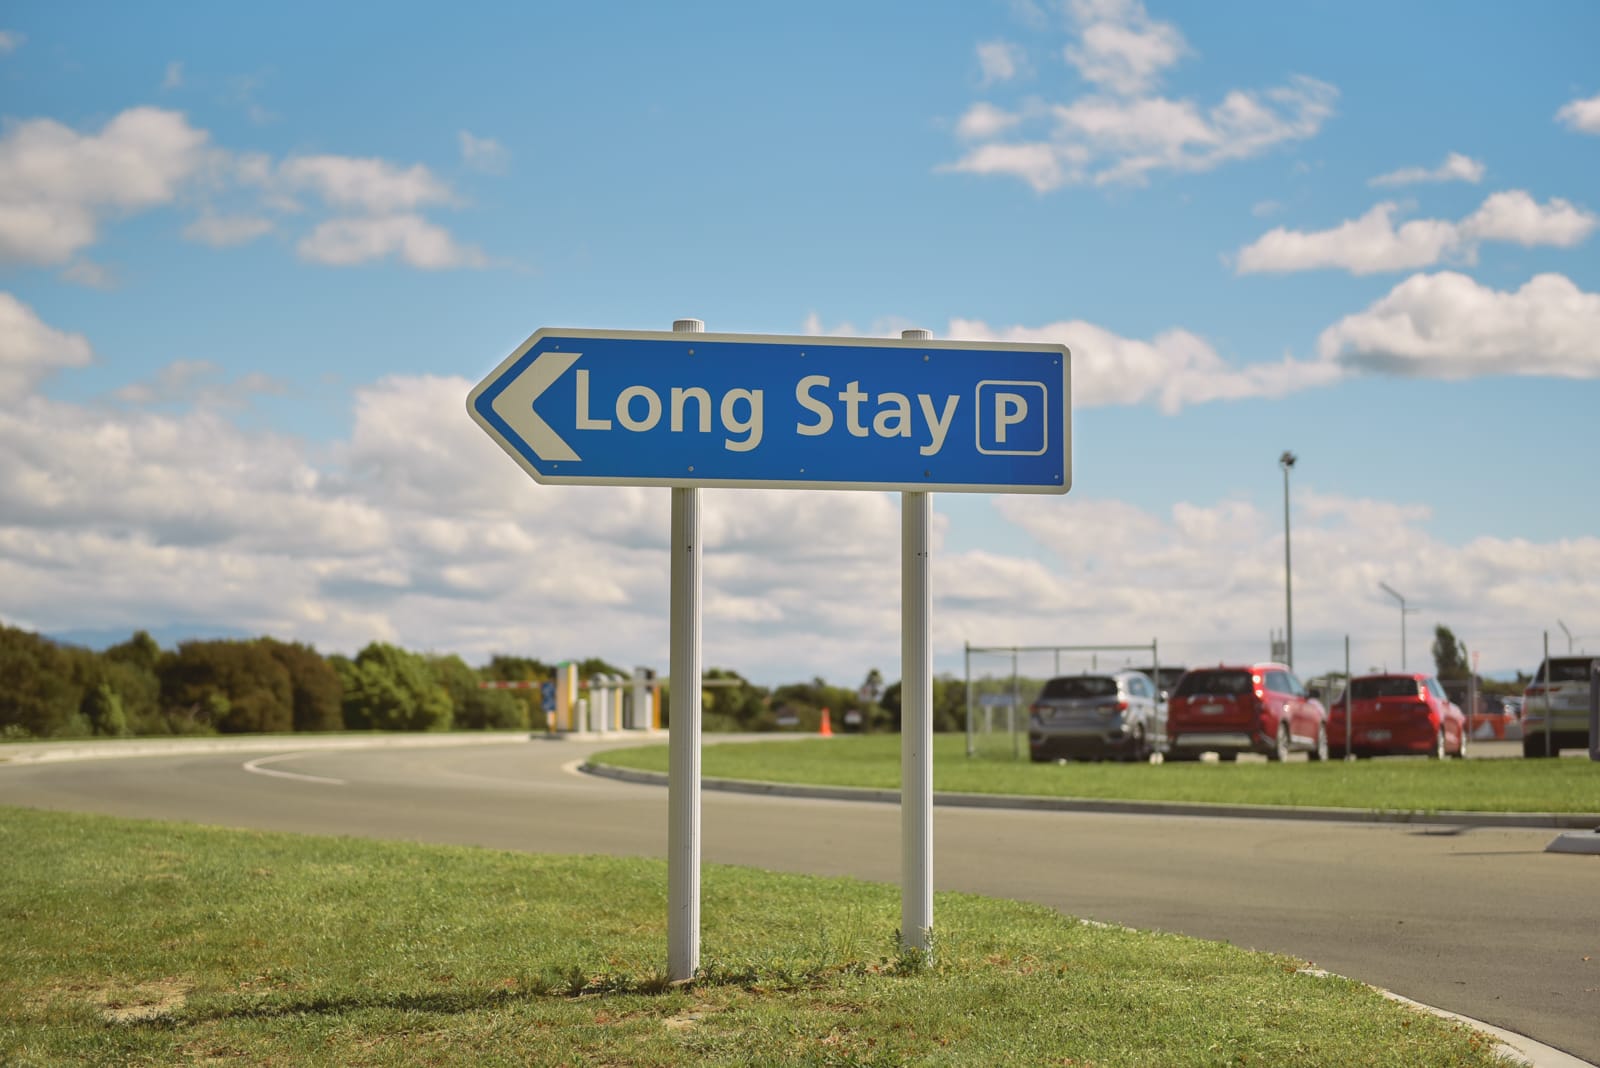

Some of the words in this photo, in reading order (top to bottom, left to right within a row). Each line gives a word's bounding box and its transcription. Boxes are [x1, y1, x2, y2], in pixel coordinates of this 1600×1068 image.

[575, 369, 763, 452] Long
[795, 375, 960, 456] Stay
[995, 393, 1028, 443] P
